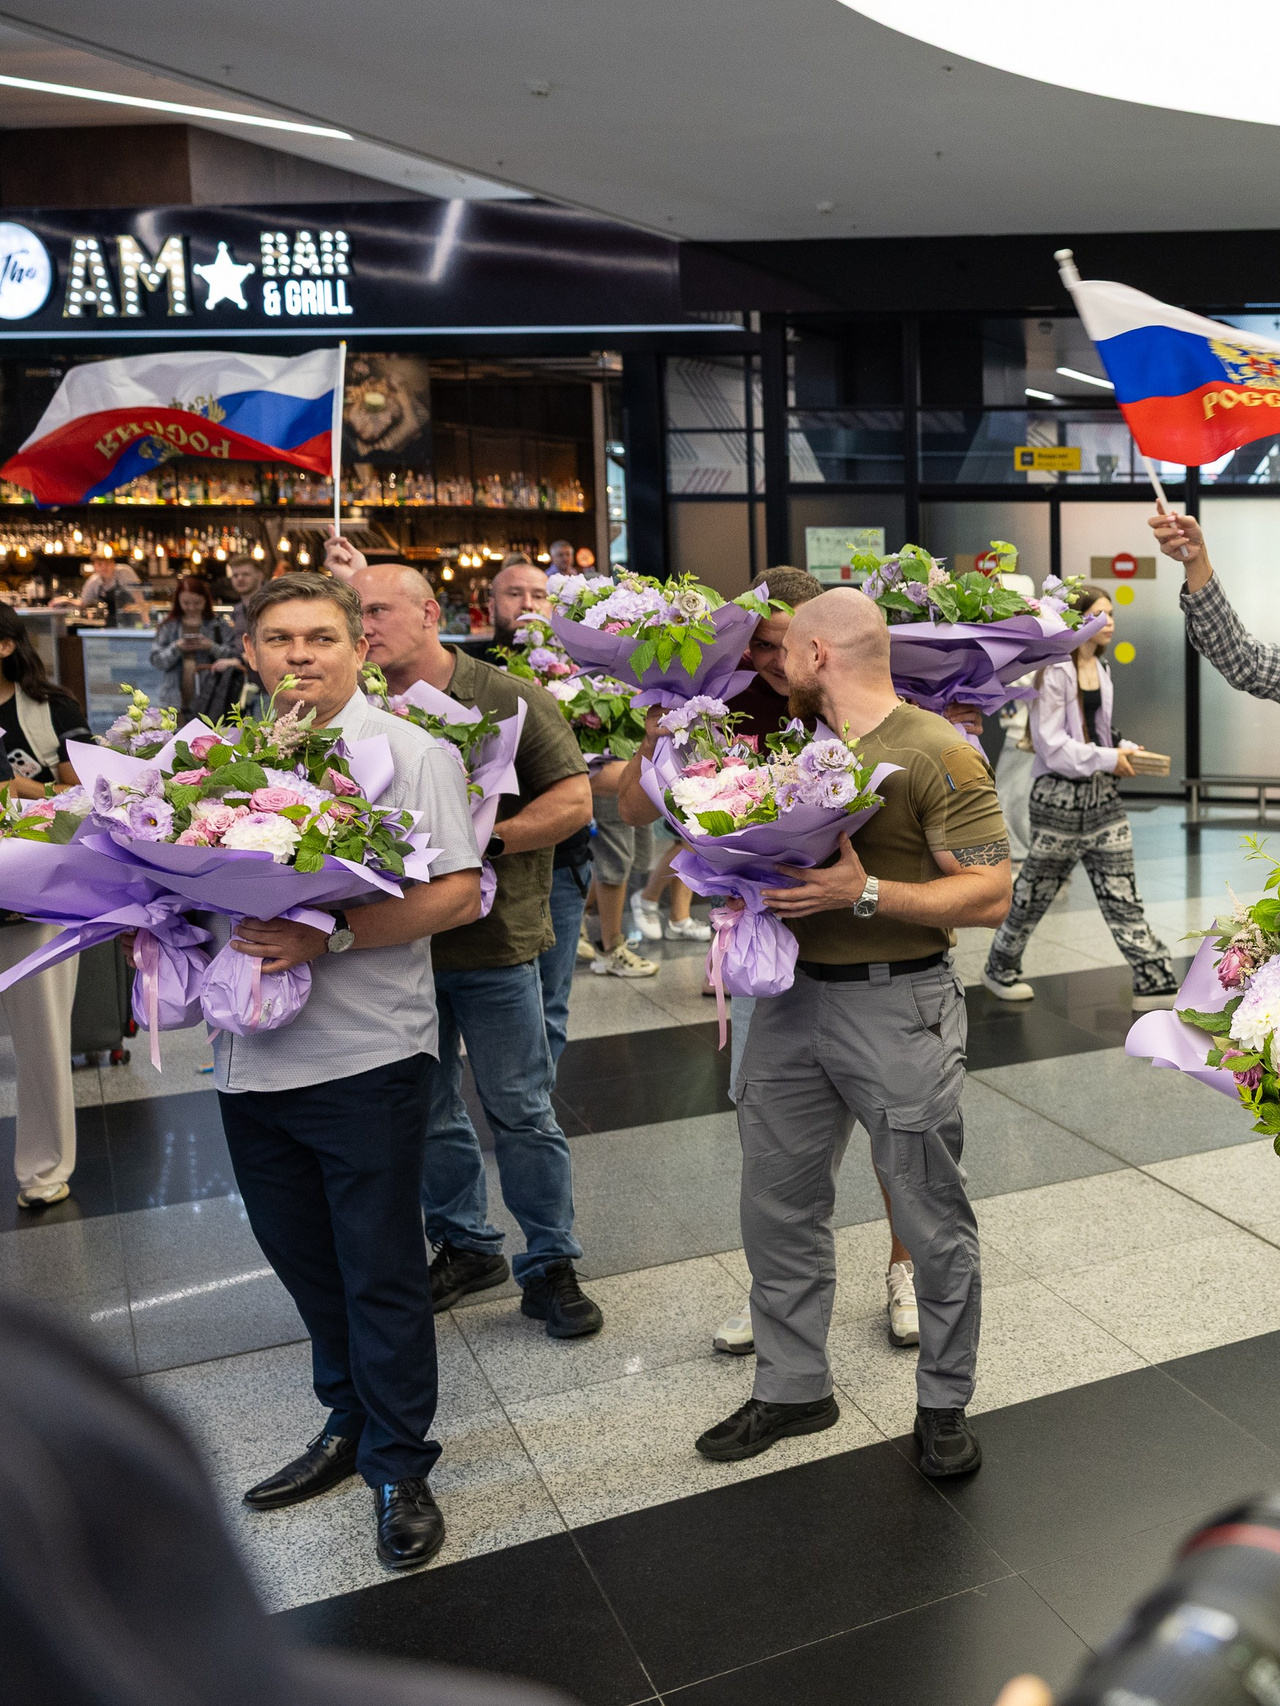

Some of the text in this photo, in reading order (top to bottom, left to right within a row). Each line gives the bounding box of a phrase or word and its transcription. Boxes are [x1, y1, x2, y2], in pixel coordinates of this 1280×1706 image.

[63, 235, 193, 318] AM
[261, 231, 350, 277] BAR
[263, 280, 353, 316] & GRILL
